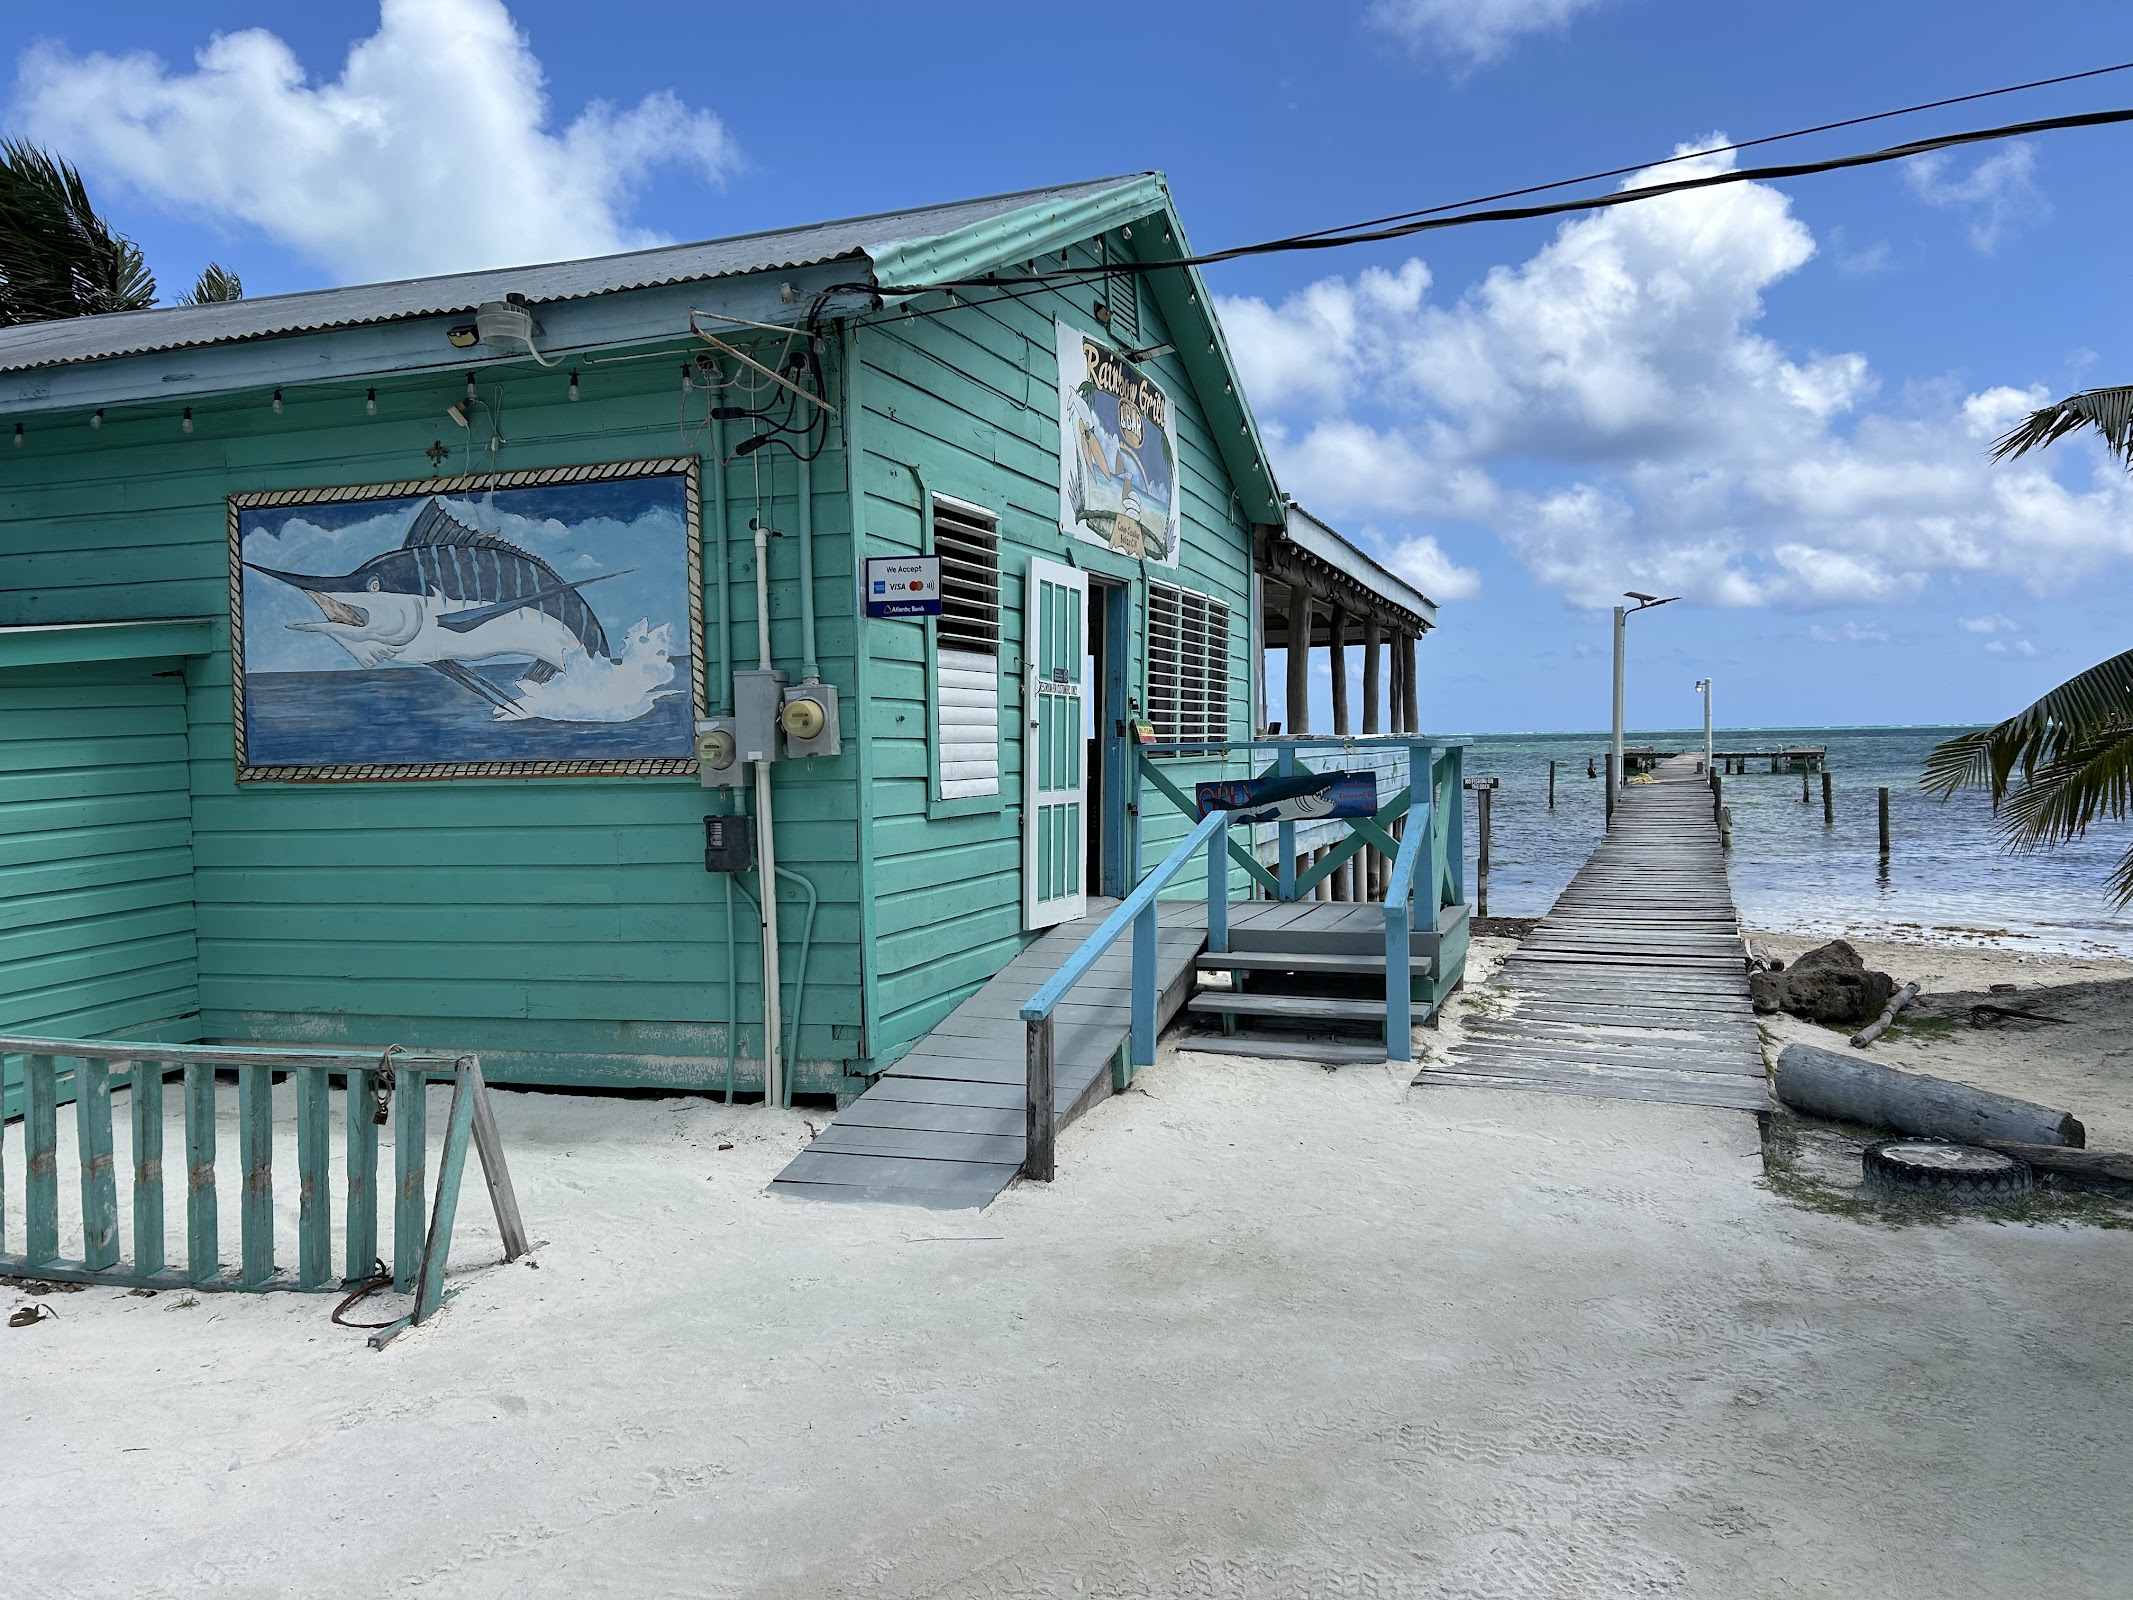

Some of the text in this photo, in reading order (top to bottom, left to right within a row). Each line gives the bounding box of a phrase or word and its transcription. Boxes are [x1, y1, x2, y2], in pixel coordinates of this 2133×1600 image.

[1083, 343, 1166, 427] Rainbow Grill
[898, 565, 922, 574] Accept
[889, 583, 906, 591] VISA
[1198, 784, 1253, 818] OPEN
